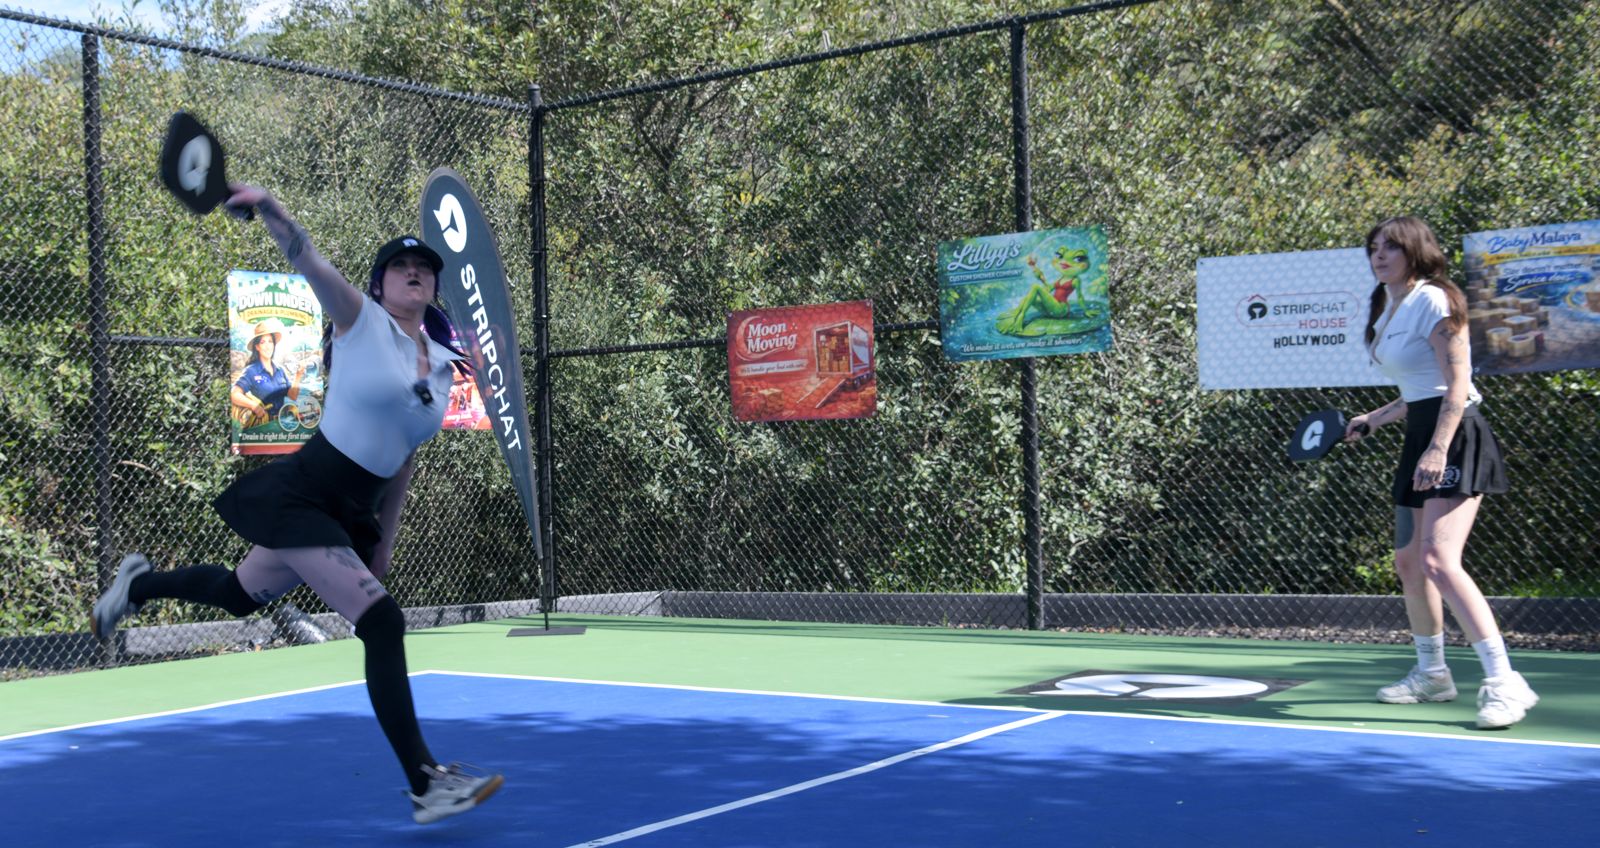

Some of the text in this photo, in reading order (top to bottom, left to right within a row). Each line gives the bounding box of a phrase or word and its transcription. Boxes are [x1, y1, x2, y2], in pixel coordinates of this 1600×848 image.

[1487, 231, 1582, 254] Baby Malaya
[1503, 275, 1546, 292] Service
[238, 291, 314, 315] DOWN UNDER
[1273, 302, 1347, 315] STRIPCHAT
[247, 308, 272, 317] DRAINAGE
[280, 309, 306, 320] PLUMBING
[748, 322, 787, 338] Moon
[1298, 317, 1347, 329] HOUSE
[746, 333, 798, 354] Moving
[1027, 339, 1046, 347] make
[1273, 333, 1346, 348] HOLLYWOOD
[460, 264, 521, 450] STRIPCHAT
[264, 432, 278, 442] right
[287, 432, 299, 442] first
